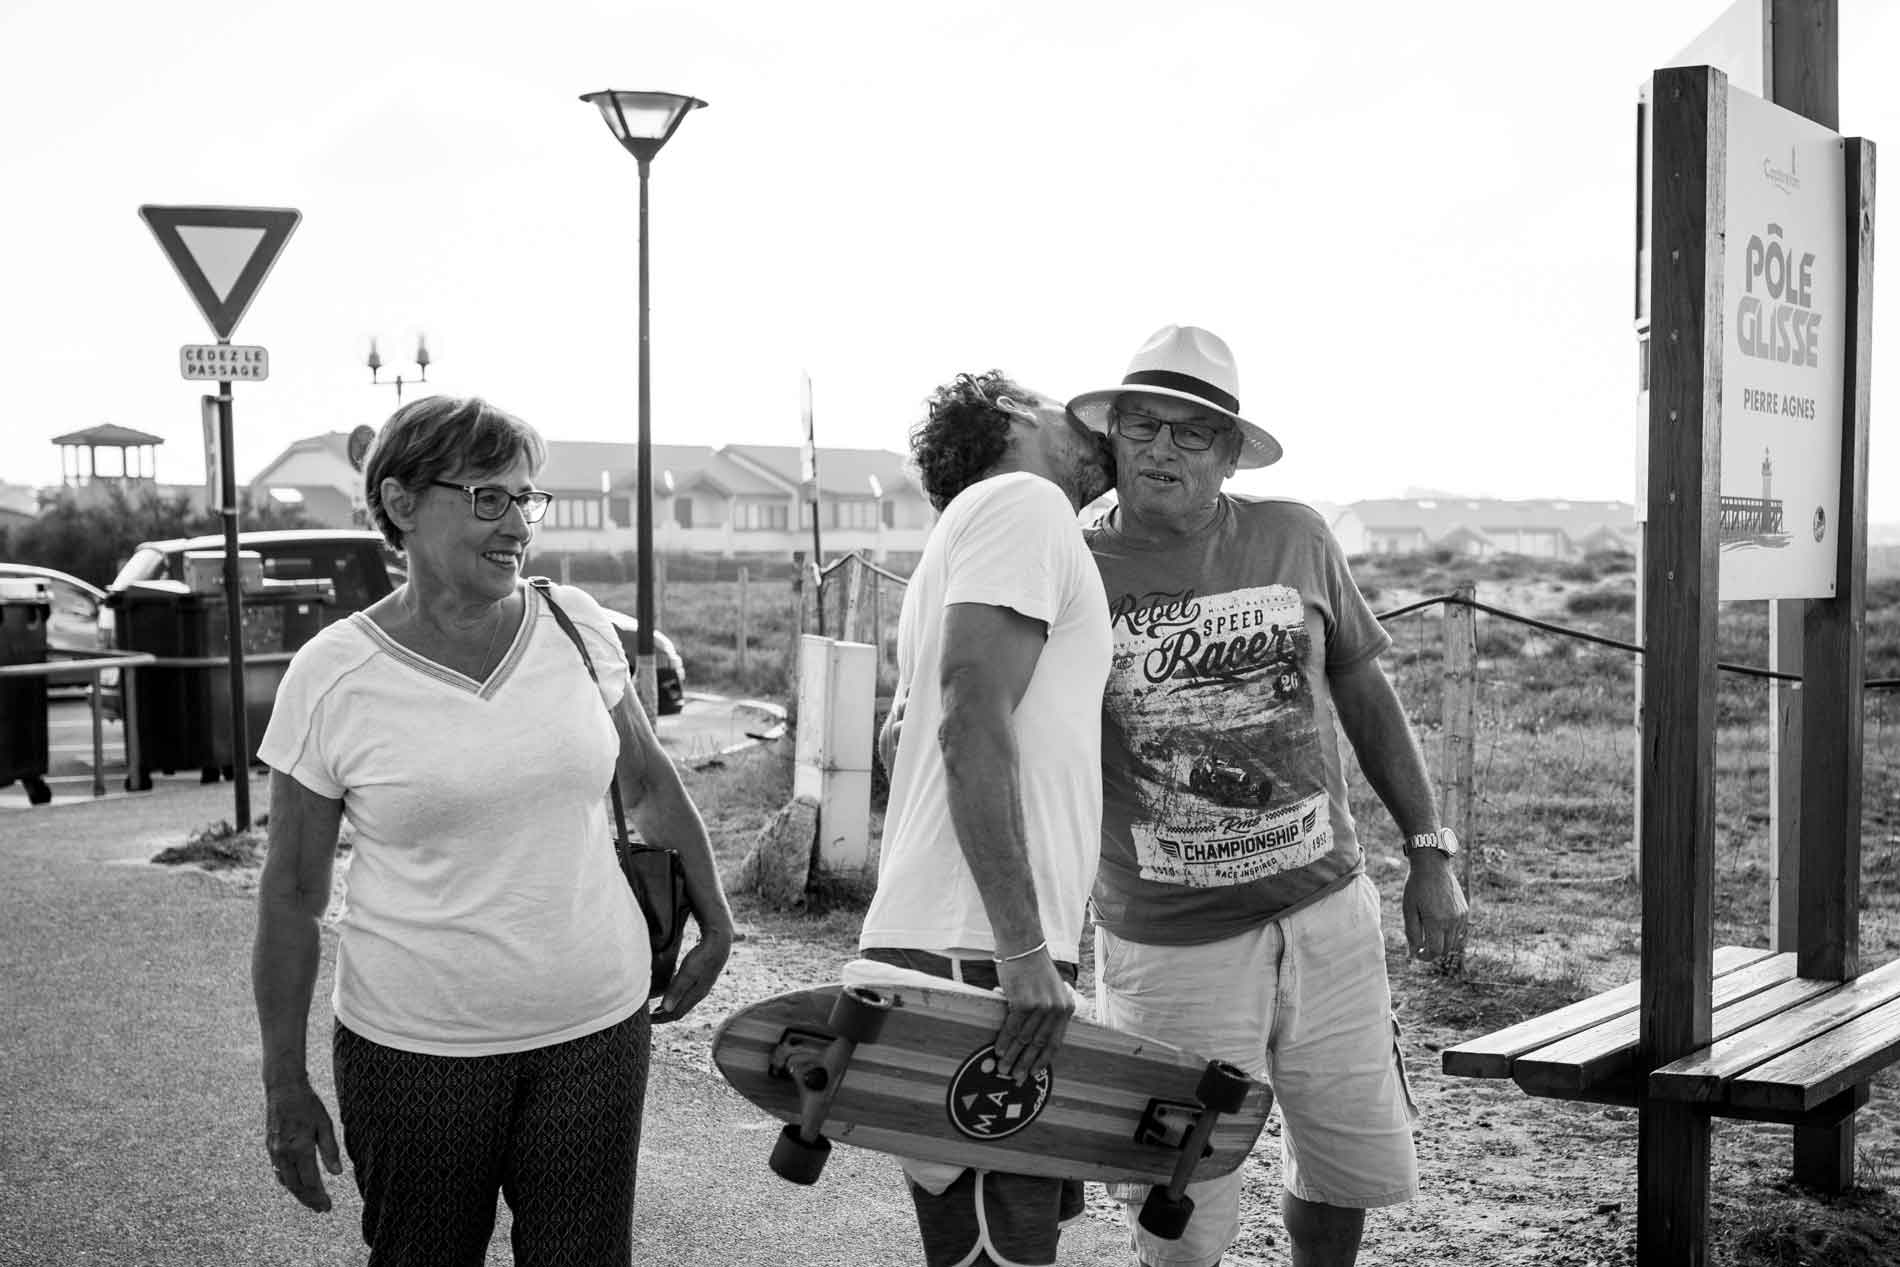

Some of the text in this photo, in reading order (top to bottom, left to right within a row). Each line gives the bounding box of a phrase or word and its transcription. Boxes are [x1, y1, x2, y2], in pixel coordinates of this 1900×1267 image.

[1745, 222, 1817, 308] PÔLE
[1737, 295, 1822, 368] GLISSE
[188, 364, 259, 377] PASSAGE
[245, 351, 262, 362] LE
[1743, 388, 1778, 414] PIERRE
[1111, 589, 1201, 638] Rebel
[1203, 609, 1264, 637] SPEED
[1144, 624, 1297, 684] Racer
[1184, 825, 1299, 861] CHAMPIONSHIP
[1216, 857, 1277, 879] RACE INSPIRED
